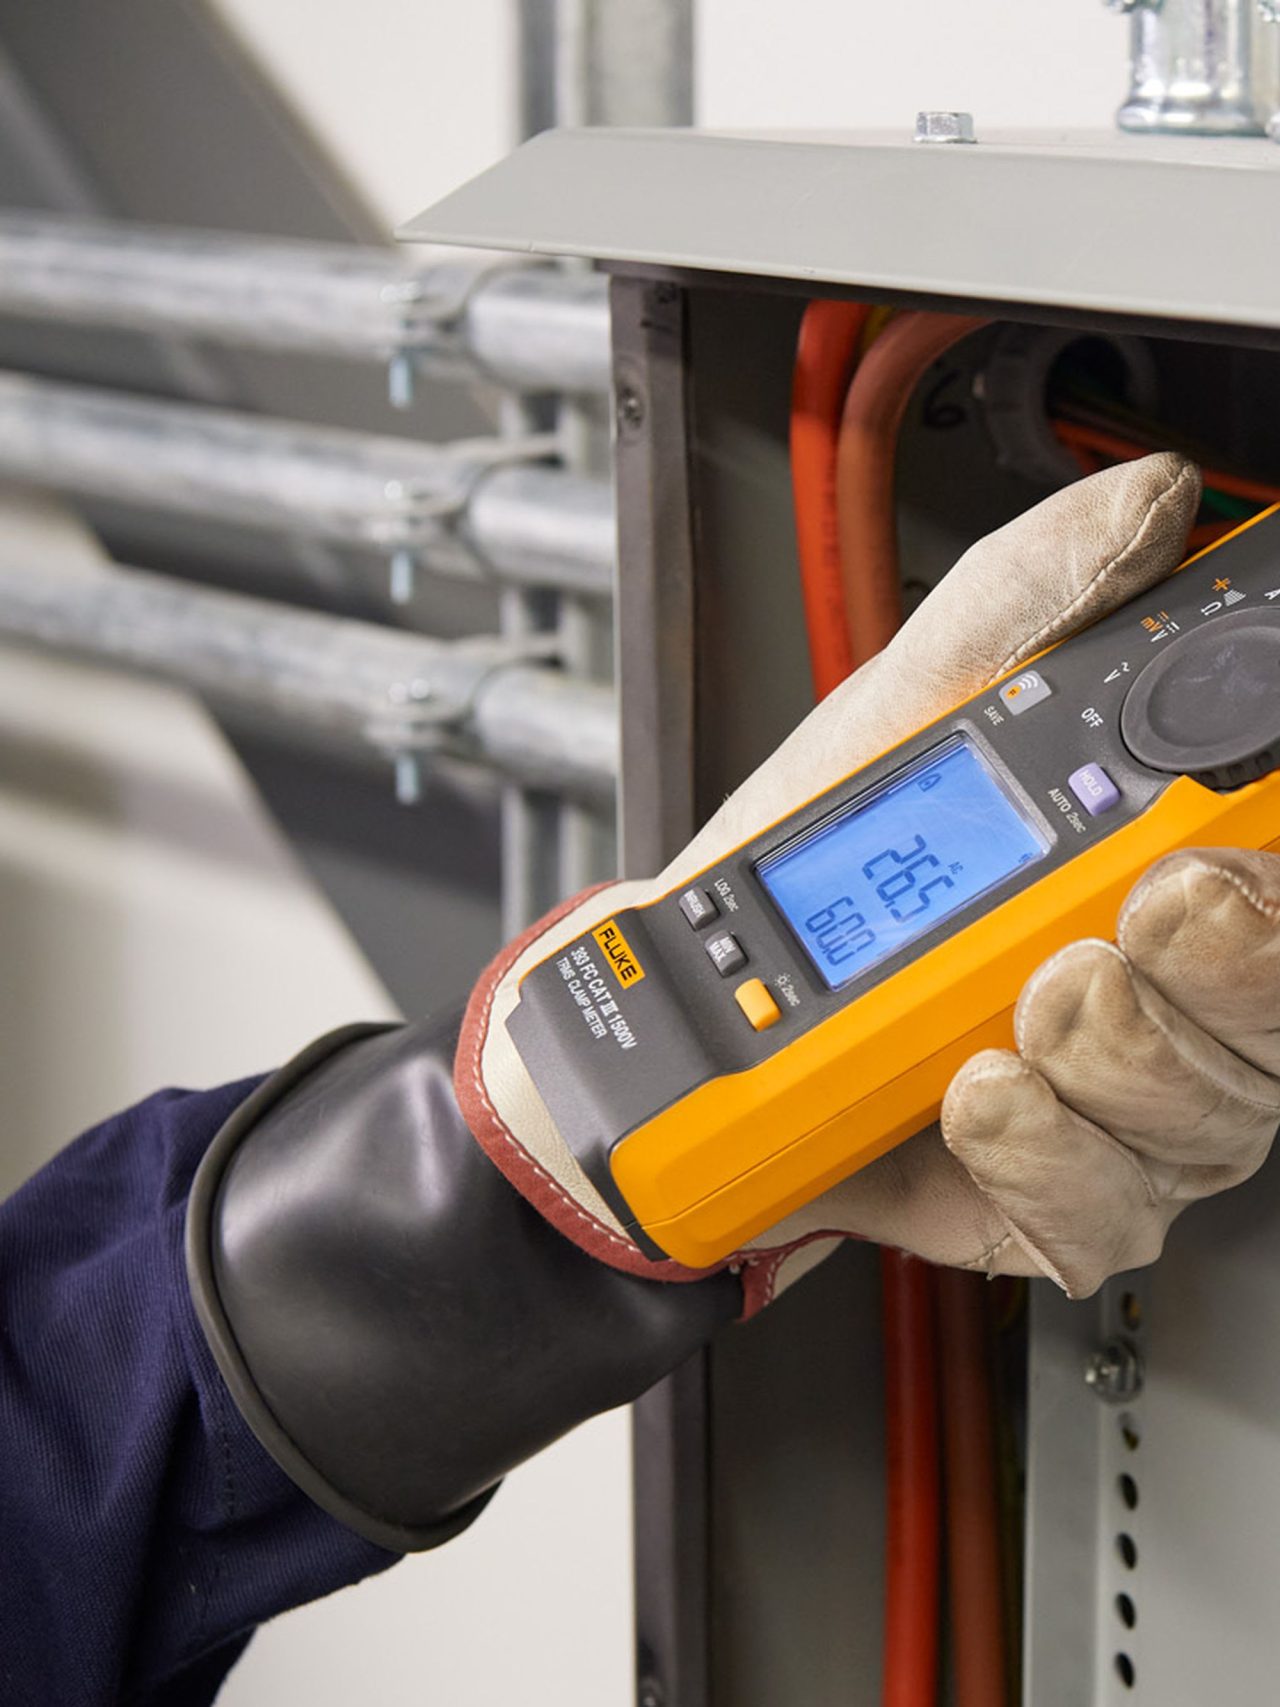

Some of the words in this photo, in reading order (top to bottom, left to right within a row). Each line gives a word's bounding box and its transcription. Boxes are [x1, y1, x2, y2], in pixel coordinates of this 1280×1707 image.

[984, 705, 1005, 726] SAVE
[1081, 707, 1104, 729] OFF
[1078, 769, 1105, 797] HOLD
[1048, 788, 1072, 813] AUTO
[1065, 811, 1087, 834] 2sec
[713, 878, 728, 897] LOG
[571, 946, 591, 967] 393
[598, 926, 638, 981] FLUKE
[708, 941, 727, 963] MAX
[580, 963, 599, 981] FC
[588, 979, 612, 1003] CAT
[567, 979, 592, 1006] CLAMP
[582, 1005, 608, 1040] METER
[608, 1014, 638, 1050] 1500V
